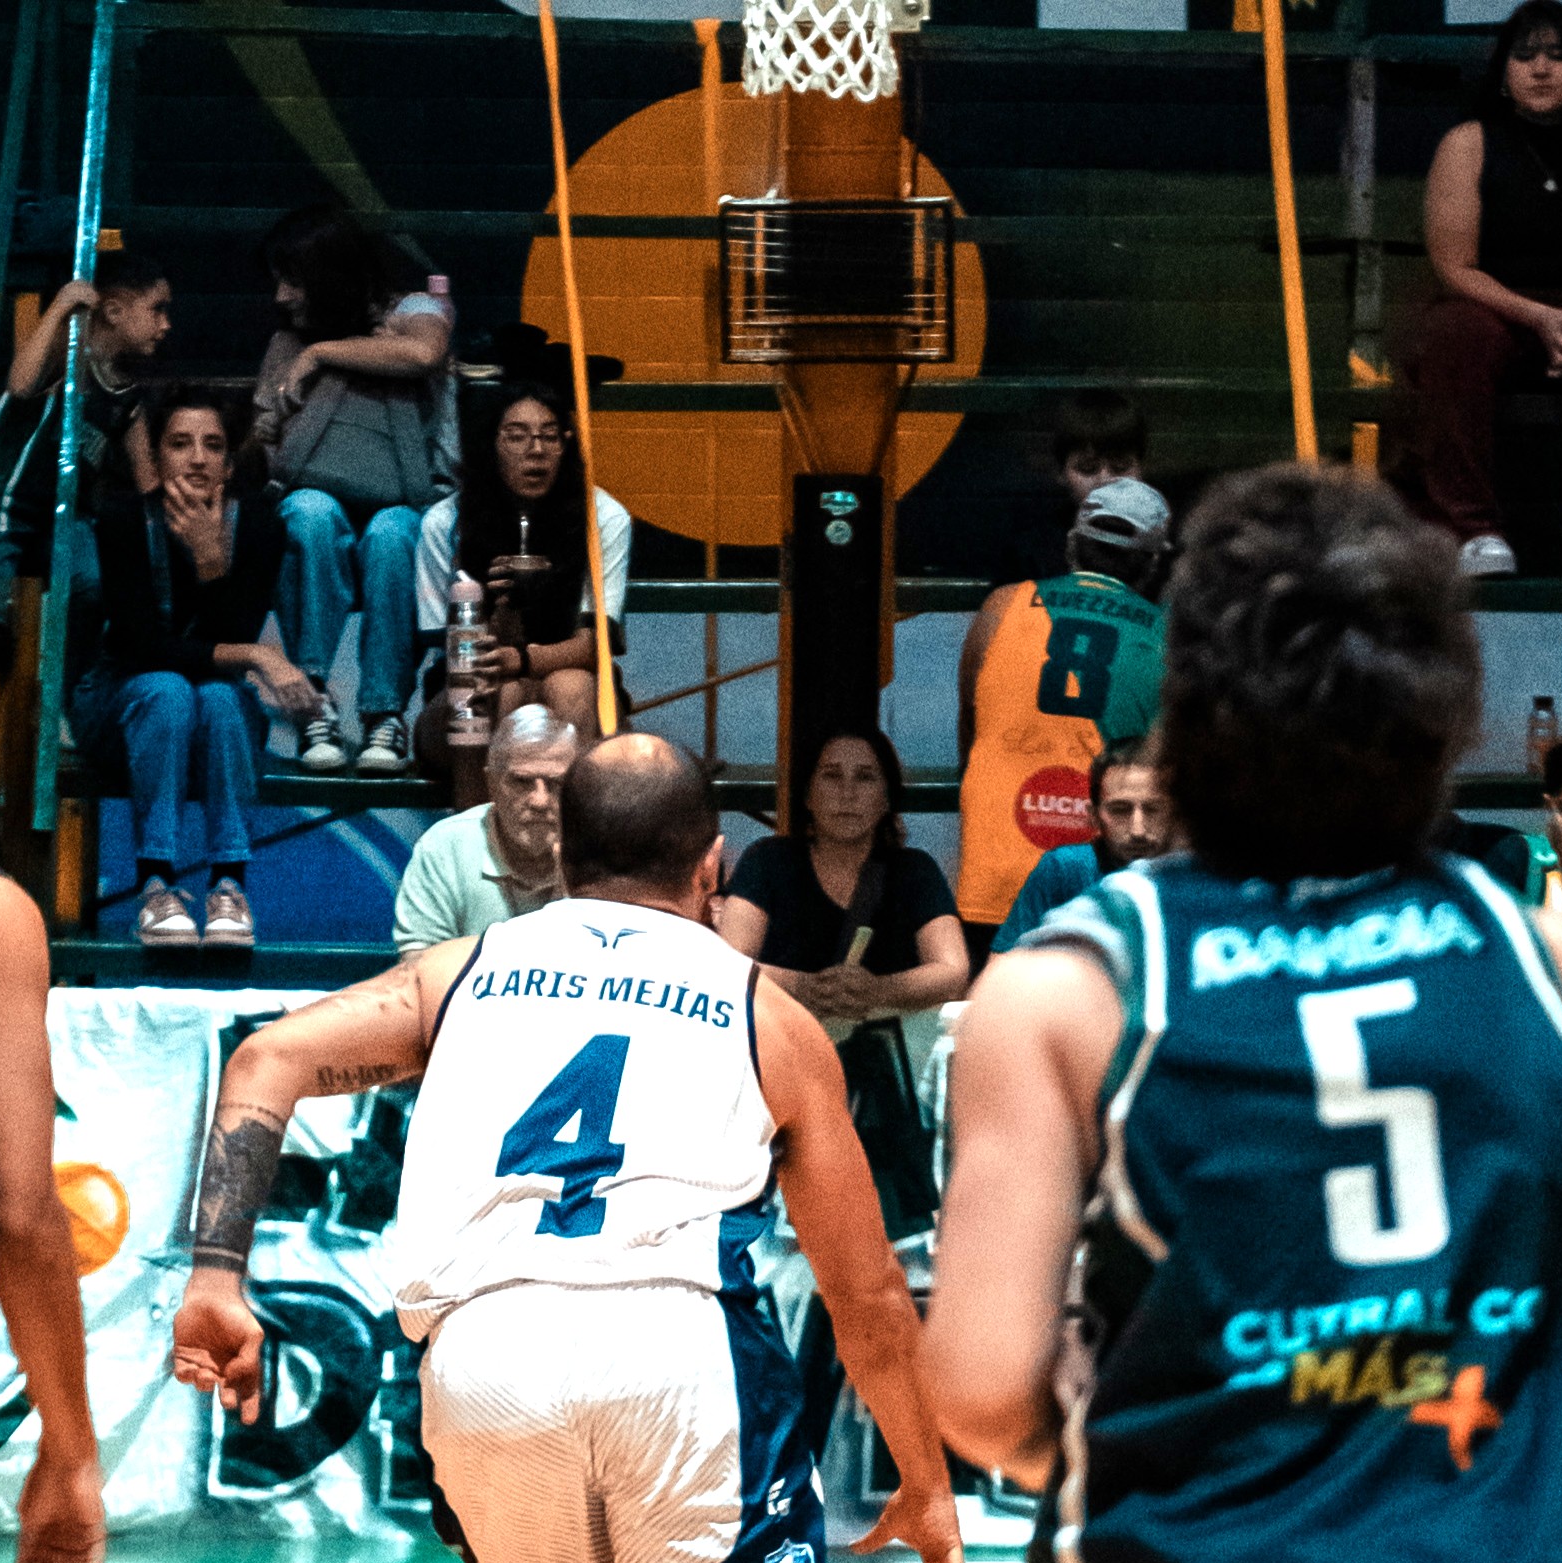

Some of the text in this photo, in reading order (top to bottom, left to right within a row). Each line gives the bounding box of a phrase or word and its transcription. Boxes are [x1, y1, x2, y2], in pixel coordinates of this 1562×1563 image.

[1037, 617, 1119, 719] 8
[598, 976, 735, 1029] MEJÍAS
[495, 1033, 630, 1239] 4
[1299, 978, 1452, 1267] 5
